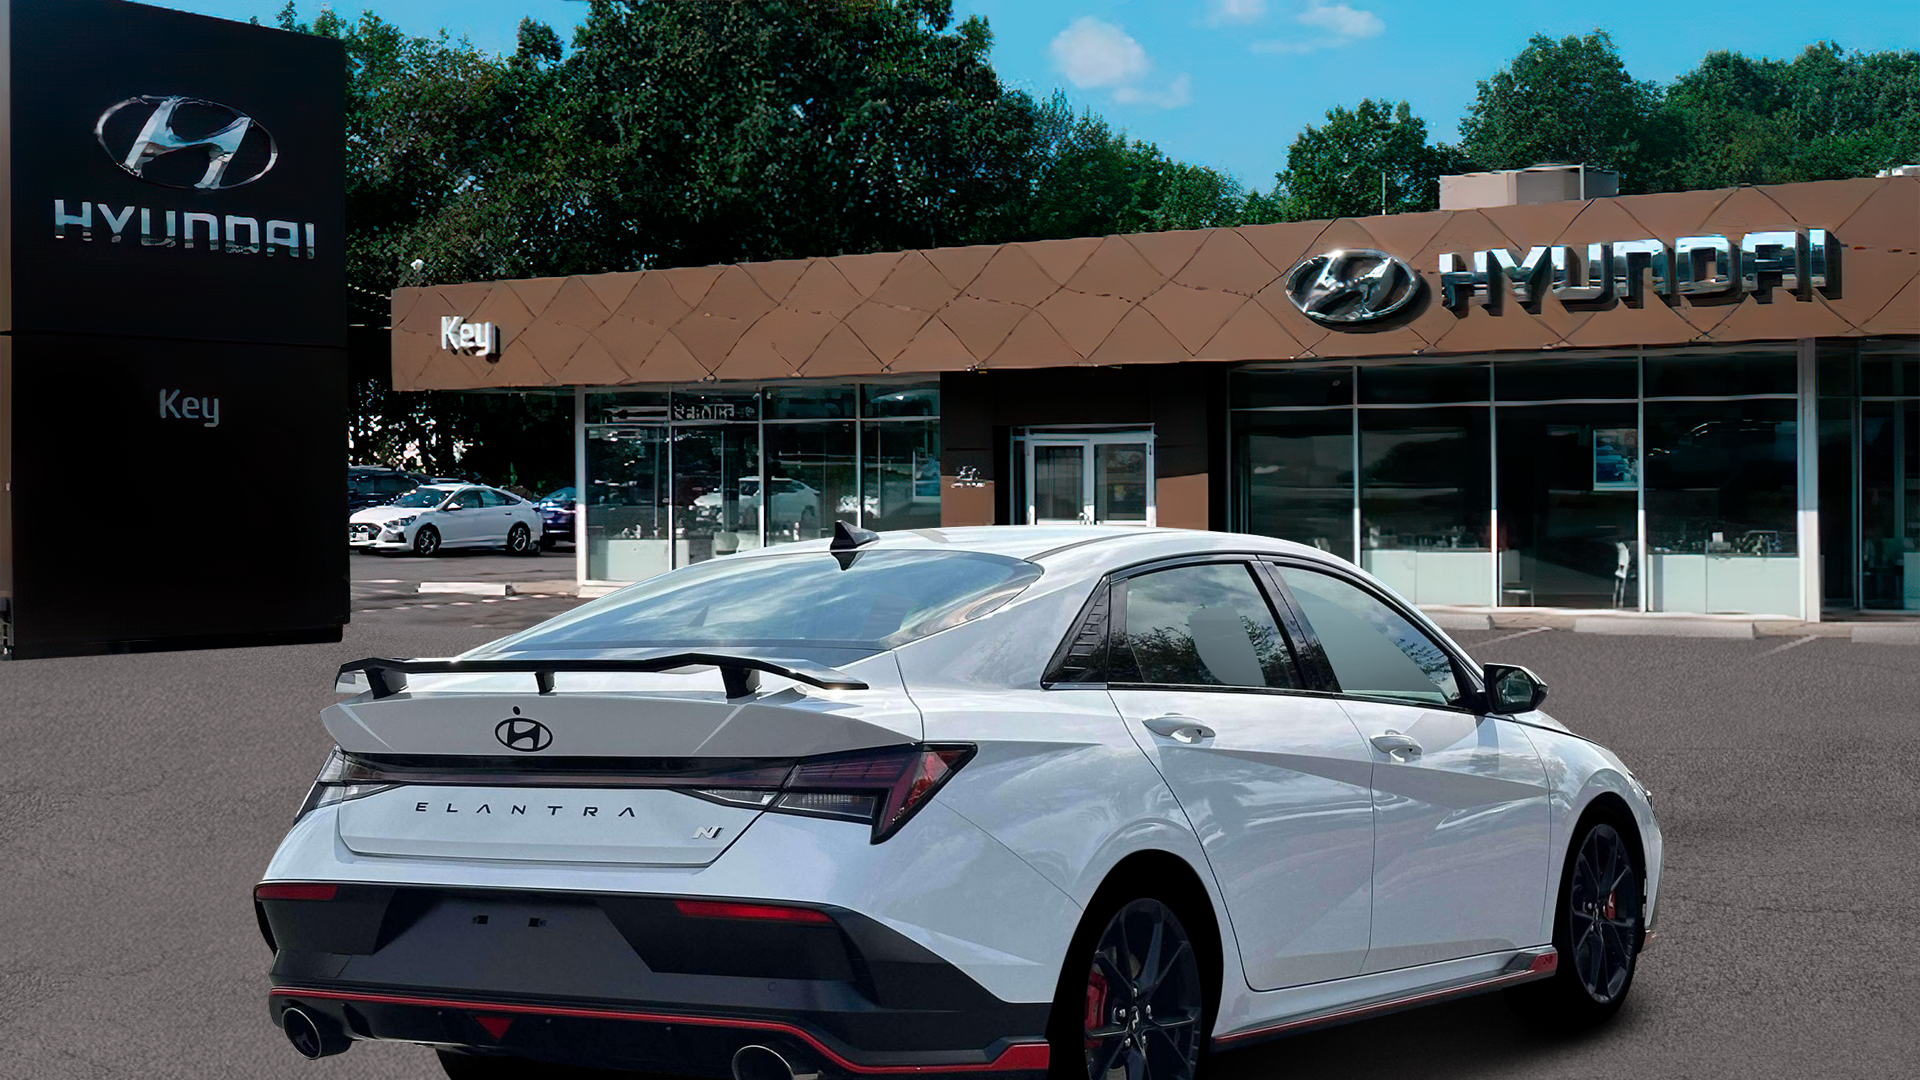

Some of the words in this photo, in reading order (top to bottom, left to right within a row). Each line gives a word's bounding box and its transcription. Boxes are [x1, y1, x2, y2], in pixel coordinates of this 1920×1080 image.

[54, 199, 315, 260] HYUNDAI
[1438, 228, 1840, 315] HYUNDAI
[441, 315, 493, 357] Key
[159, 388, 220, 428] Key
[415, 802, 636, 818] ELANTRA
